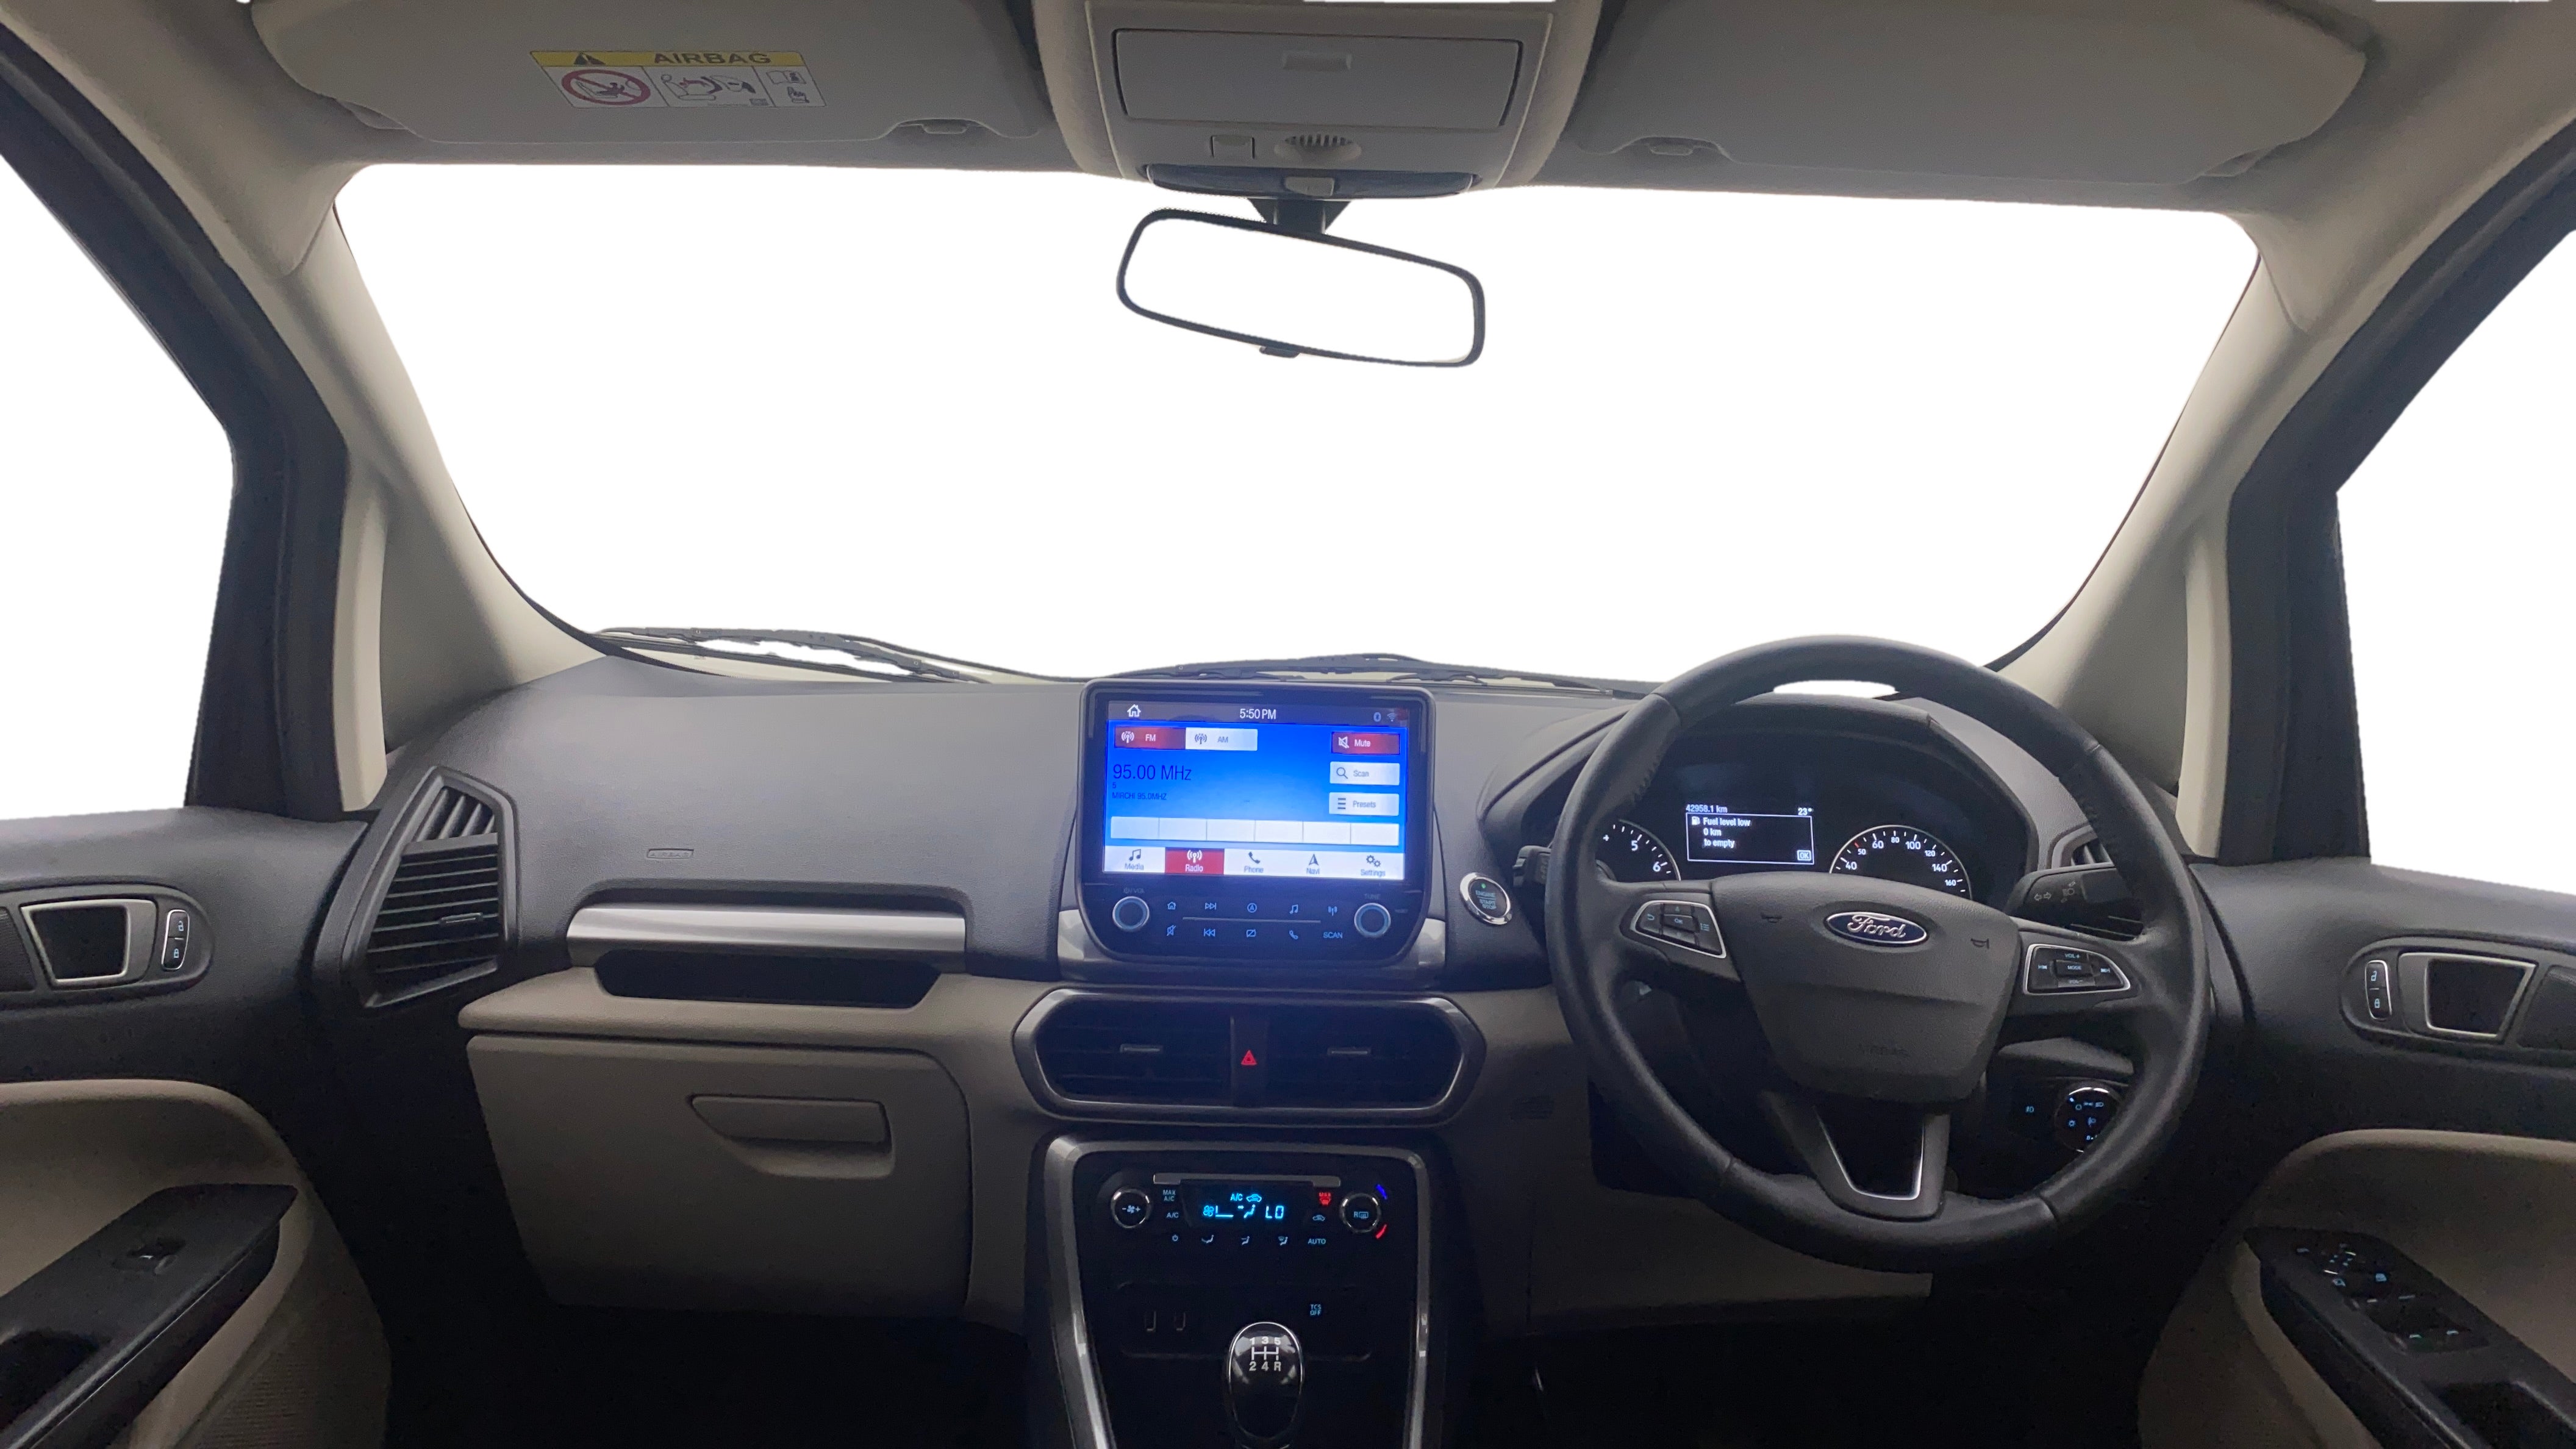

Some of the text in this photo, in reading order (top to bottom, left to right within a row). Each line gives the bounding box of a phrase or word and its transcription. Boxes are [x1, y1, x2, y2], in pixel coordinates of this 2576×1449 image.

[653, 52, 772, 64] AIRBAG
[1239, 708, 1277, 720] 5:50 PM
[1145, 734, 1156, 742] FM
[1354, 739, 1371, 748] Mute
[1112, 764, 1192, 781] 95.00 MHz
[1353, 769, 1370, 778] Scan
[1112, 791, 1167, 801] MIRCHI 95.0MHZ
[1353, 800, 1376, 809] Presets
[1686, 804, 1714, 812] 42958.1
[1703, 817, 1719, 826] Fuel
[1720, 818, 1736, 826] level
[1631, 840, 1639, 851] 5
[1712, 840, 1735, 849] empty
[1872, 840, 1884, 849] 60
[1905, 841, 1922, 850] 100
[1125, 862, 1145, 871] Media
[1185, 863, 1204, 873] Radio
[1243, 865, 1264, 873] Phone
[1652, 861, 1661, 872] 6
[1845, 861, 1858, 870] 40
[1931, 863, 1948, 872] 140
[1360, 868, 1386, 878] Settings
[1847, 914, 1906, 939] Ford
[1250, 1336, 1281, 1345] 1 3 5
[1249, 1361, 1281, 1372] 2 4 R
